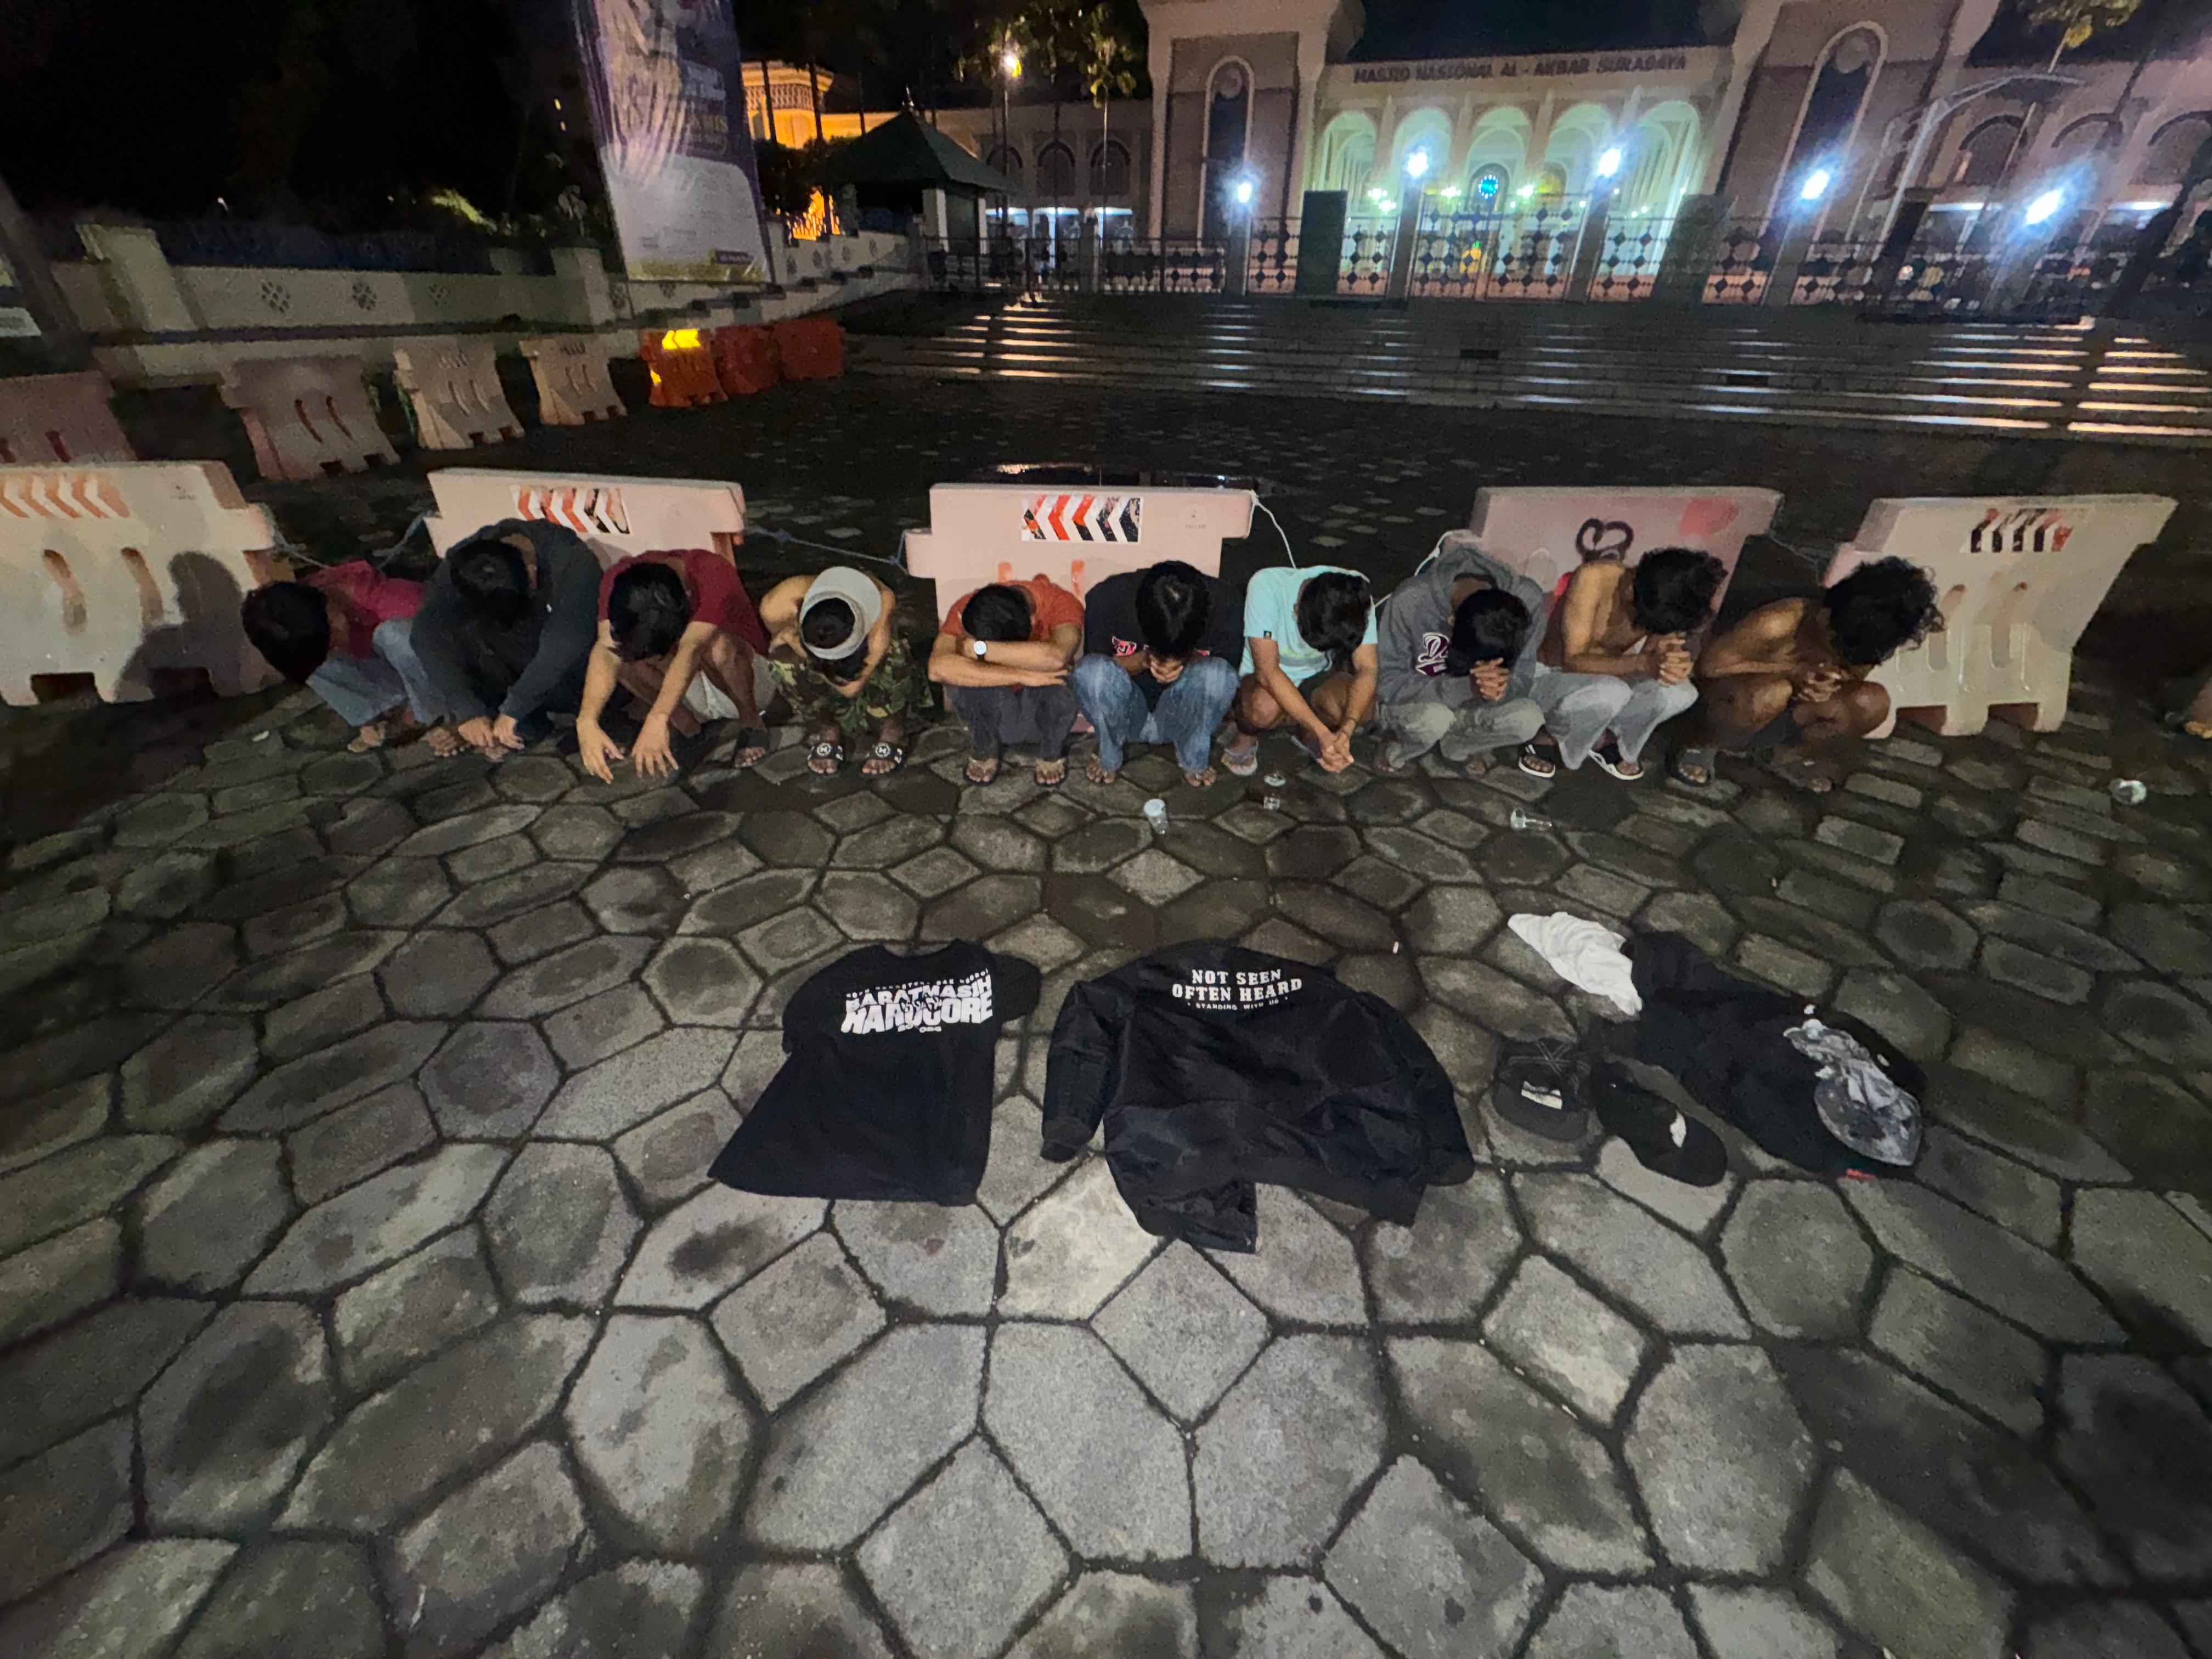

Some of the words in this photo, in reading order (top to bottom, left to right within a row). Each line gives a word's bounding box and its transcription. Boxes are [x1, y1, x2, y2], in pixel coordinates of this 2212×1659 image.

[1415, 64, 1492, 81] NASIONAL
[1500, 61, 1517, 76] AL
[1534, 57, 1590, 76] AKBAR
[1597, 54, 1686, 73] SURABAYA
[1192, 969, 1229, 985] NOT
[1236, 969, 1281, 986] SEEN
[1172, 983, 1231, 1001] OFTEN
[1239, 978, 1302, 1002] HEARD
[1195, 1002, 1238, 1011] STANDING
[1243, 1002, 1264, 1010] WITH
